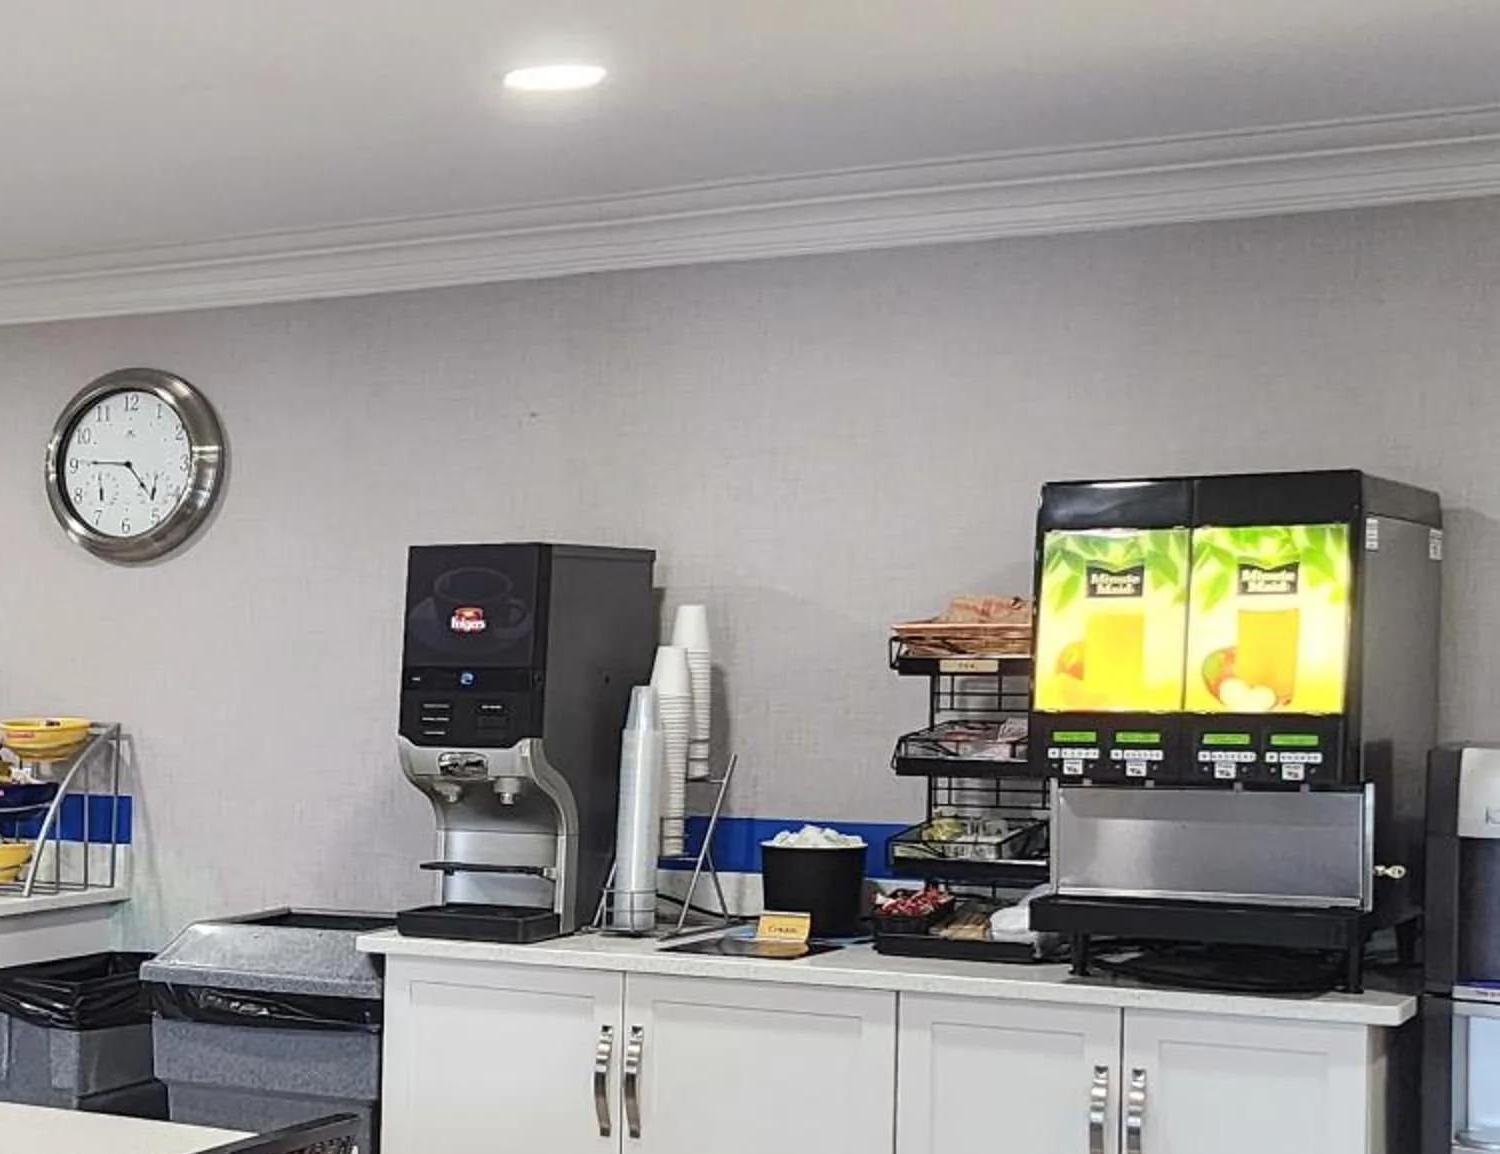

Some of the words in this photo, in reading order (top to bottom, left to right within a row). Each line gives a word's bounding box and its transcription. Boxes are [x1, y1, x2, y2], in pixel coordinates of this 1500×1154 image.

[123, 394, 140, 412] 12
[155, 403, 163, 420] 1
[95, 406, 111, 423] 11
[76, 428, 92, 446] 10
[175, 424, 185, 441] 2
[69, 458, 80, 474] 9
[179, 454, 190, 472] 3
[73, 488, 84, 505] 8
[93, 510, 103, 526] 7
[150, 507, 161, 525] 5
[120, 519, 132, 534] 6
